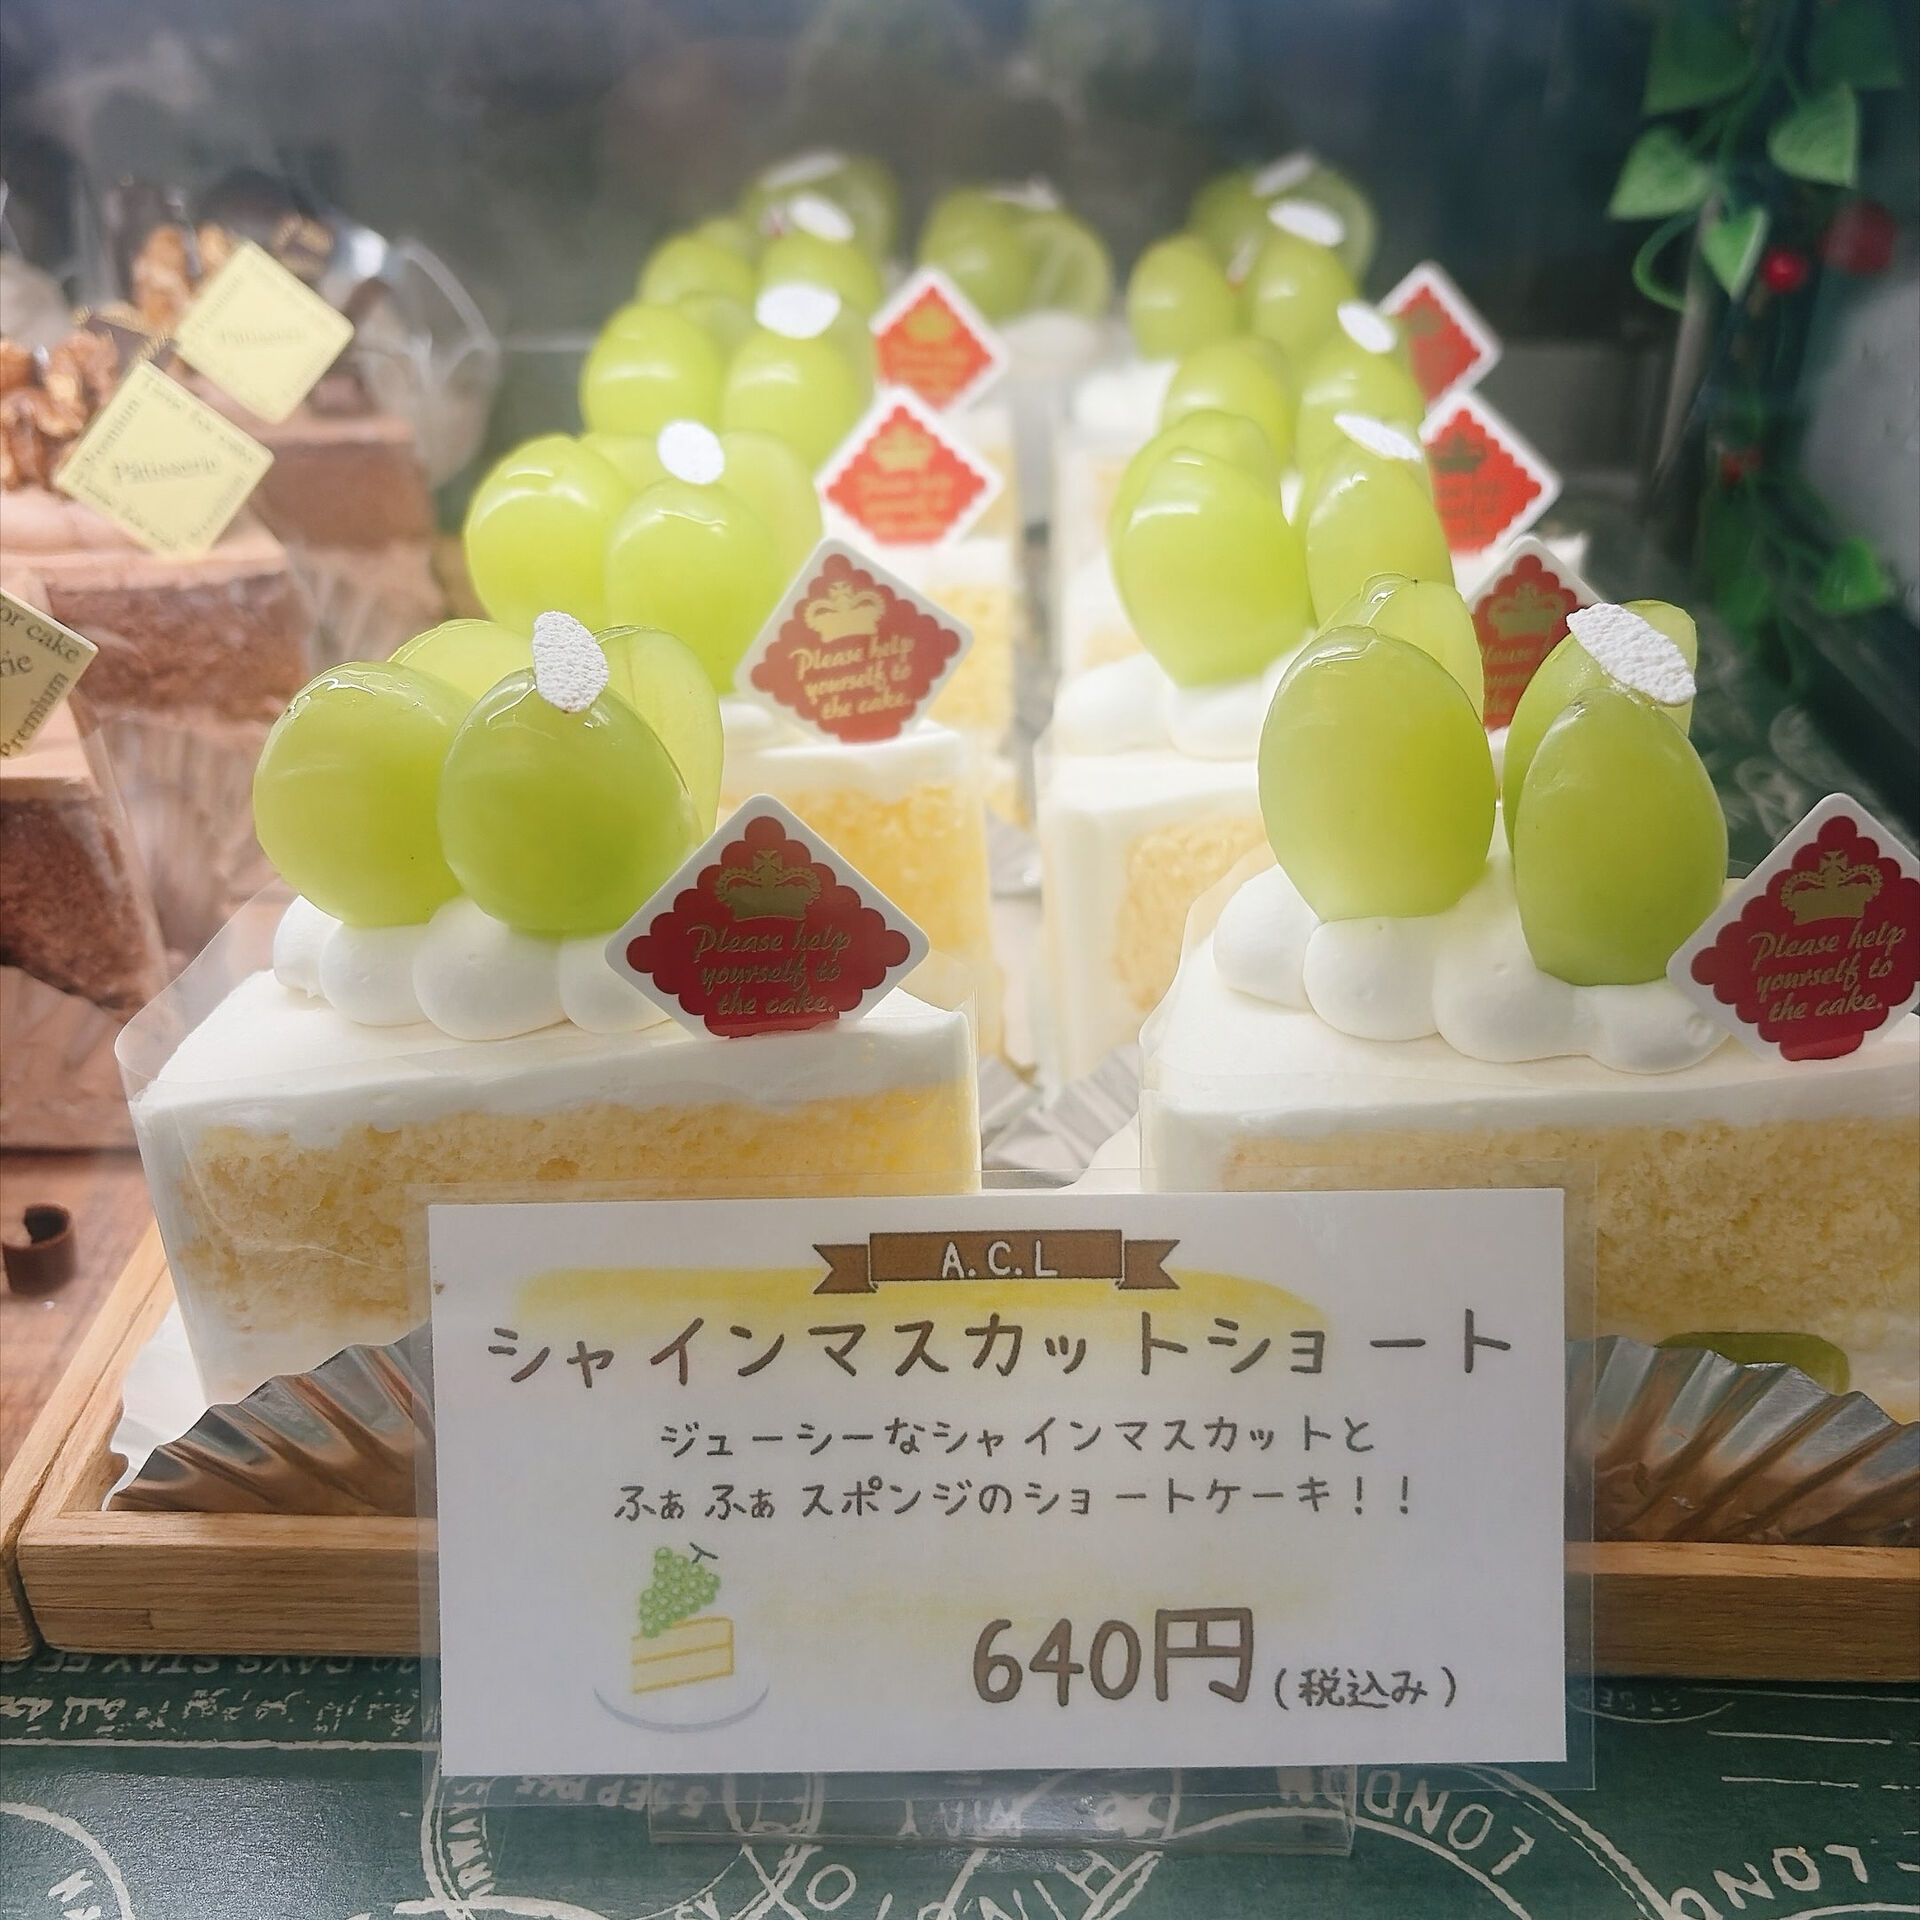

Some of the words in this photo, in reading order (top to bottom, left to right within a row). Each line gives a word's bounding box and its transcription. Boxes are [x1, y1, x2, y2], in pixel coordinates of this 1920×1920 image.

[26, 622, 80, 663] cake
[687, 925, 783, 963] Please
[791, 922, 851, 961] help
[1748, 930, 1840, 971] Please
[1847, 919, 1907, 957] help
[701, 957, 808, 995] yourself
[815, 960, 843, 982] to
[1755, 951, 1863, 1004] yourself
[1868, 957, 1894, 979] to
[717, 987, 757, 1016] the
[764, 987, 836, 1016] cake.
[1768, 991, 1807, 1023] the
[1814, 986, 1883, 1018] cake.
[941, 1239, 1059, 1280] A.C.L
[487, 1308, 1512, 1388] シャインマスカットショート
[660, 1414, 1375, 1459] ジューシーなシャインマスカットと
[972, 1606, 1254, 1708] 640円
